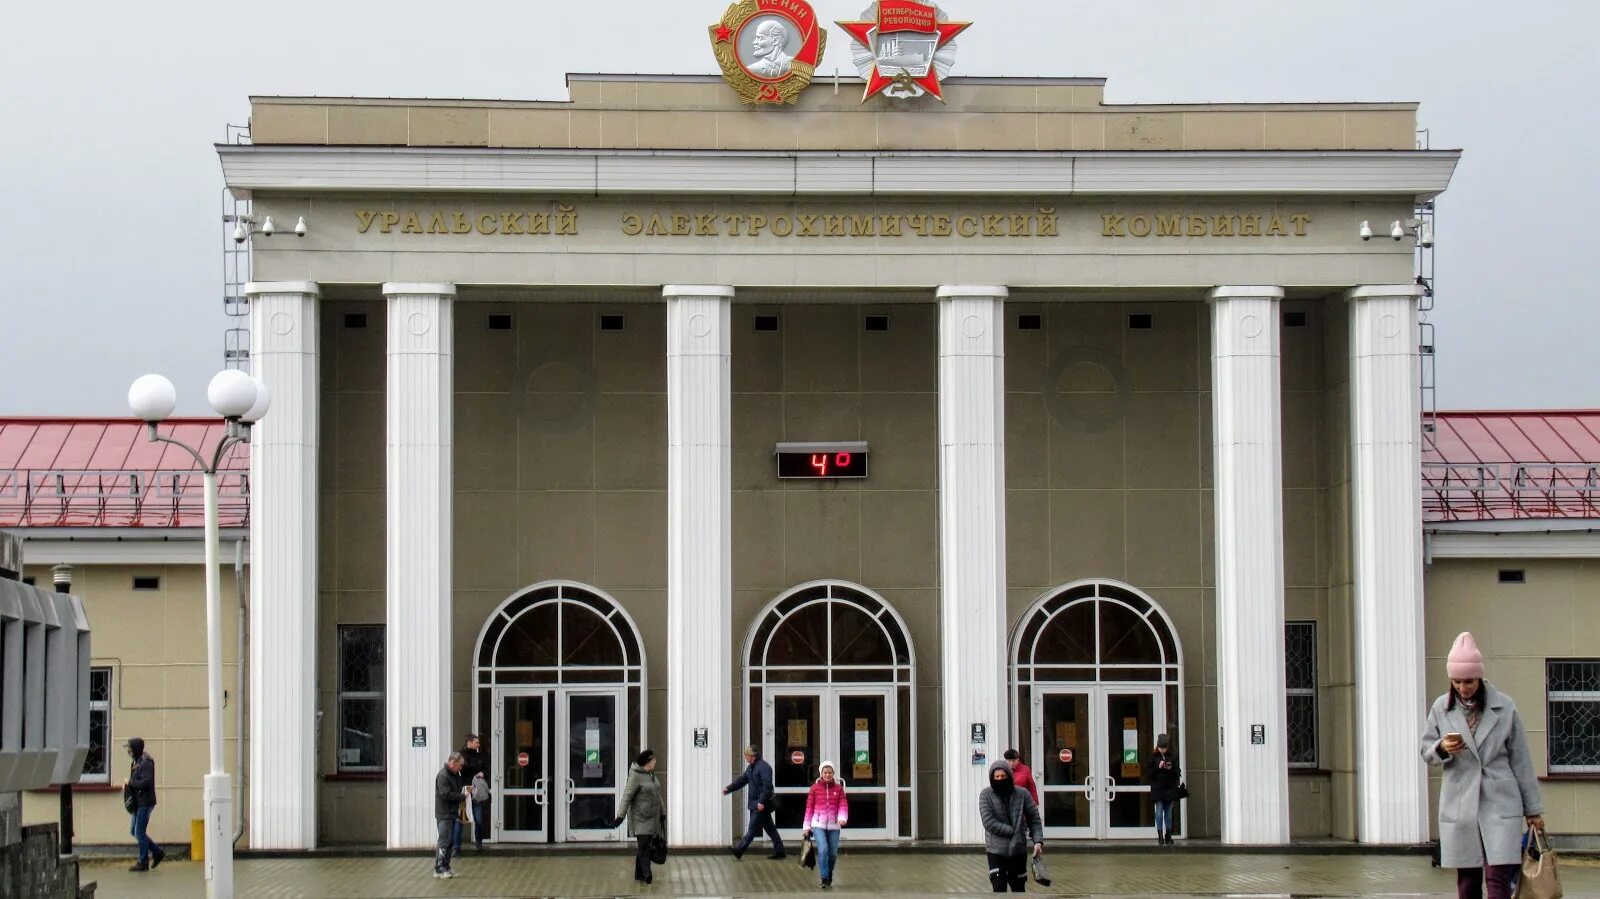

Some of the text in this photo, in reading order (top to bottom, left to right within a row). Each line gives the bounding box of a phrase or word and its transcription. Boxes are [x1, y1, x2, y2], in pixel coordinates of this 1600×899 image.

[882, 7, 933, 18] ОКТЯБРЬСКАЯ
[883, 16, 932, 26] РЕВОЛЮЦИЯ
[354, 204, 1312, 237] УРАЛЬСКИЙ ЭЛЕКТРОХИМИЧЕСКИЙ КОМБИНАТ
